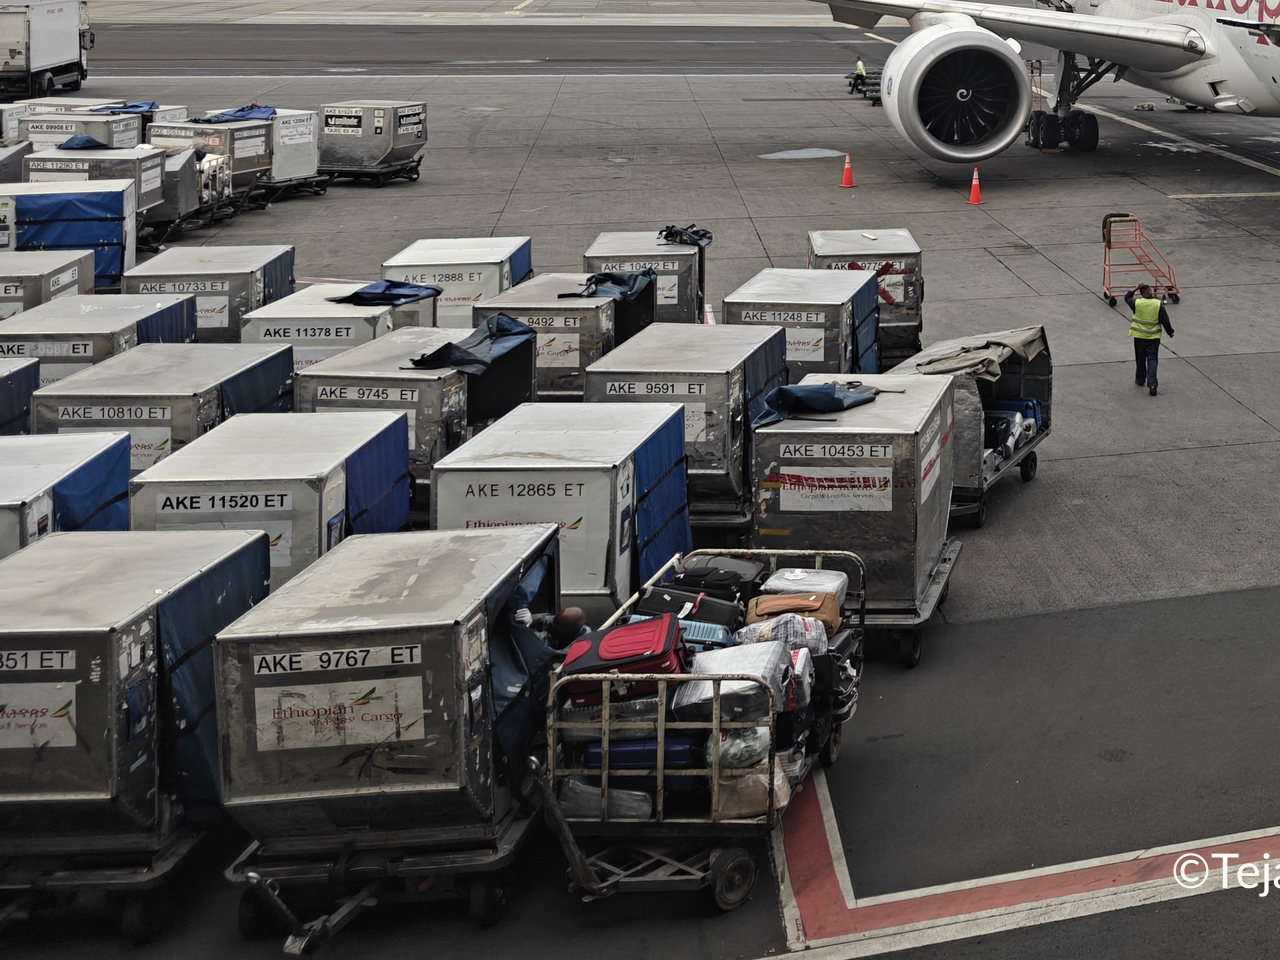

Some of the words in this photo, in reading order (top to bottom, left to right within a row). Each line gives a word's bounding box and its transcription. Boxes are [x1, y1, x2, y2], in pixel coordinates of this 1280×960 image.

[604, 263, 625, 271] AKE
[663, 261, 676, 270] ET
[51, 276, 60, 288] AKE
[71, 268, 77, 279] ET
[404, 274, 427, 283] AKE
[432, 273, 464, 282] 12888
[468, 272, 483, 281] ET
[4, 285, 21, 295] ET
[141, 283, 167, 293] AKE
[172, 282, 207, 292] 10733
[210, 281, 226, 291] ET
[527, 317, 555, 327] 9492
[564, 317, 579, 327] ET
[744, 312, 767, 321] AKE
[771, 312, 802, 322] 11248
[806, 312, 820, 322] ET
[263, 328, 291, 338] AKE
[295, 327, 331, 337] 11378
[335, 327, 352, 337] ET
[0, 344, 25, 355] AKE
[72, 343, 89, 354] ET
[319, 388, 348, 399] AKE
[357, 388, 388, 400] 9745
[400, 390, 417, 400] ET
[609, 383, 636, 394] AKE
[646, 383, 675, 394] 9591
[688, 383, 705, 394] ET
[60, 407, 93, 419] AKE
[99, 407, 143, 419] 10810
[149, 407, 168, 418] ET
[782, 445, 814, 457] AKE
[821, 445, 864, 457] 10453
[870, 445, 890, 457] ET
[465, 484, 500, 497] AKE
[508, 484, 556, 497] 12865
[565, 483, 585, 497] ET
[161, 496, 201, 510] AKE
[208, 494, 259, 509] 11520
[264, 494, 288, 508] ET
[40, 651, 69, 668] ET
[257, 654, 302, 673] AKE
[319, 649, 371, 669] 9767
[391, 646, 418, 664] ET
[272, 703, 354, 720] Ethiopian
[361, 711, 403, 723] Cargo
